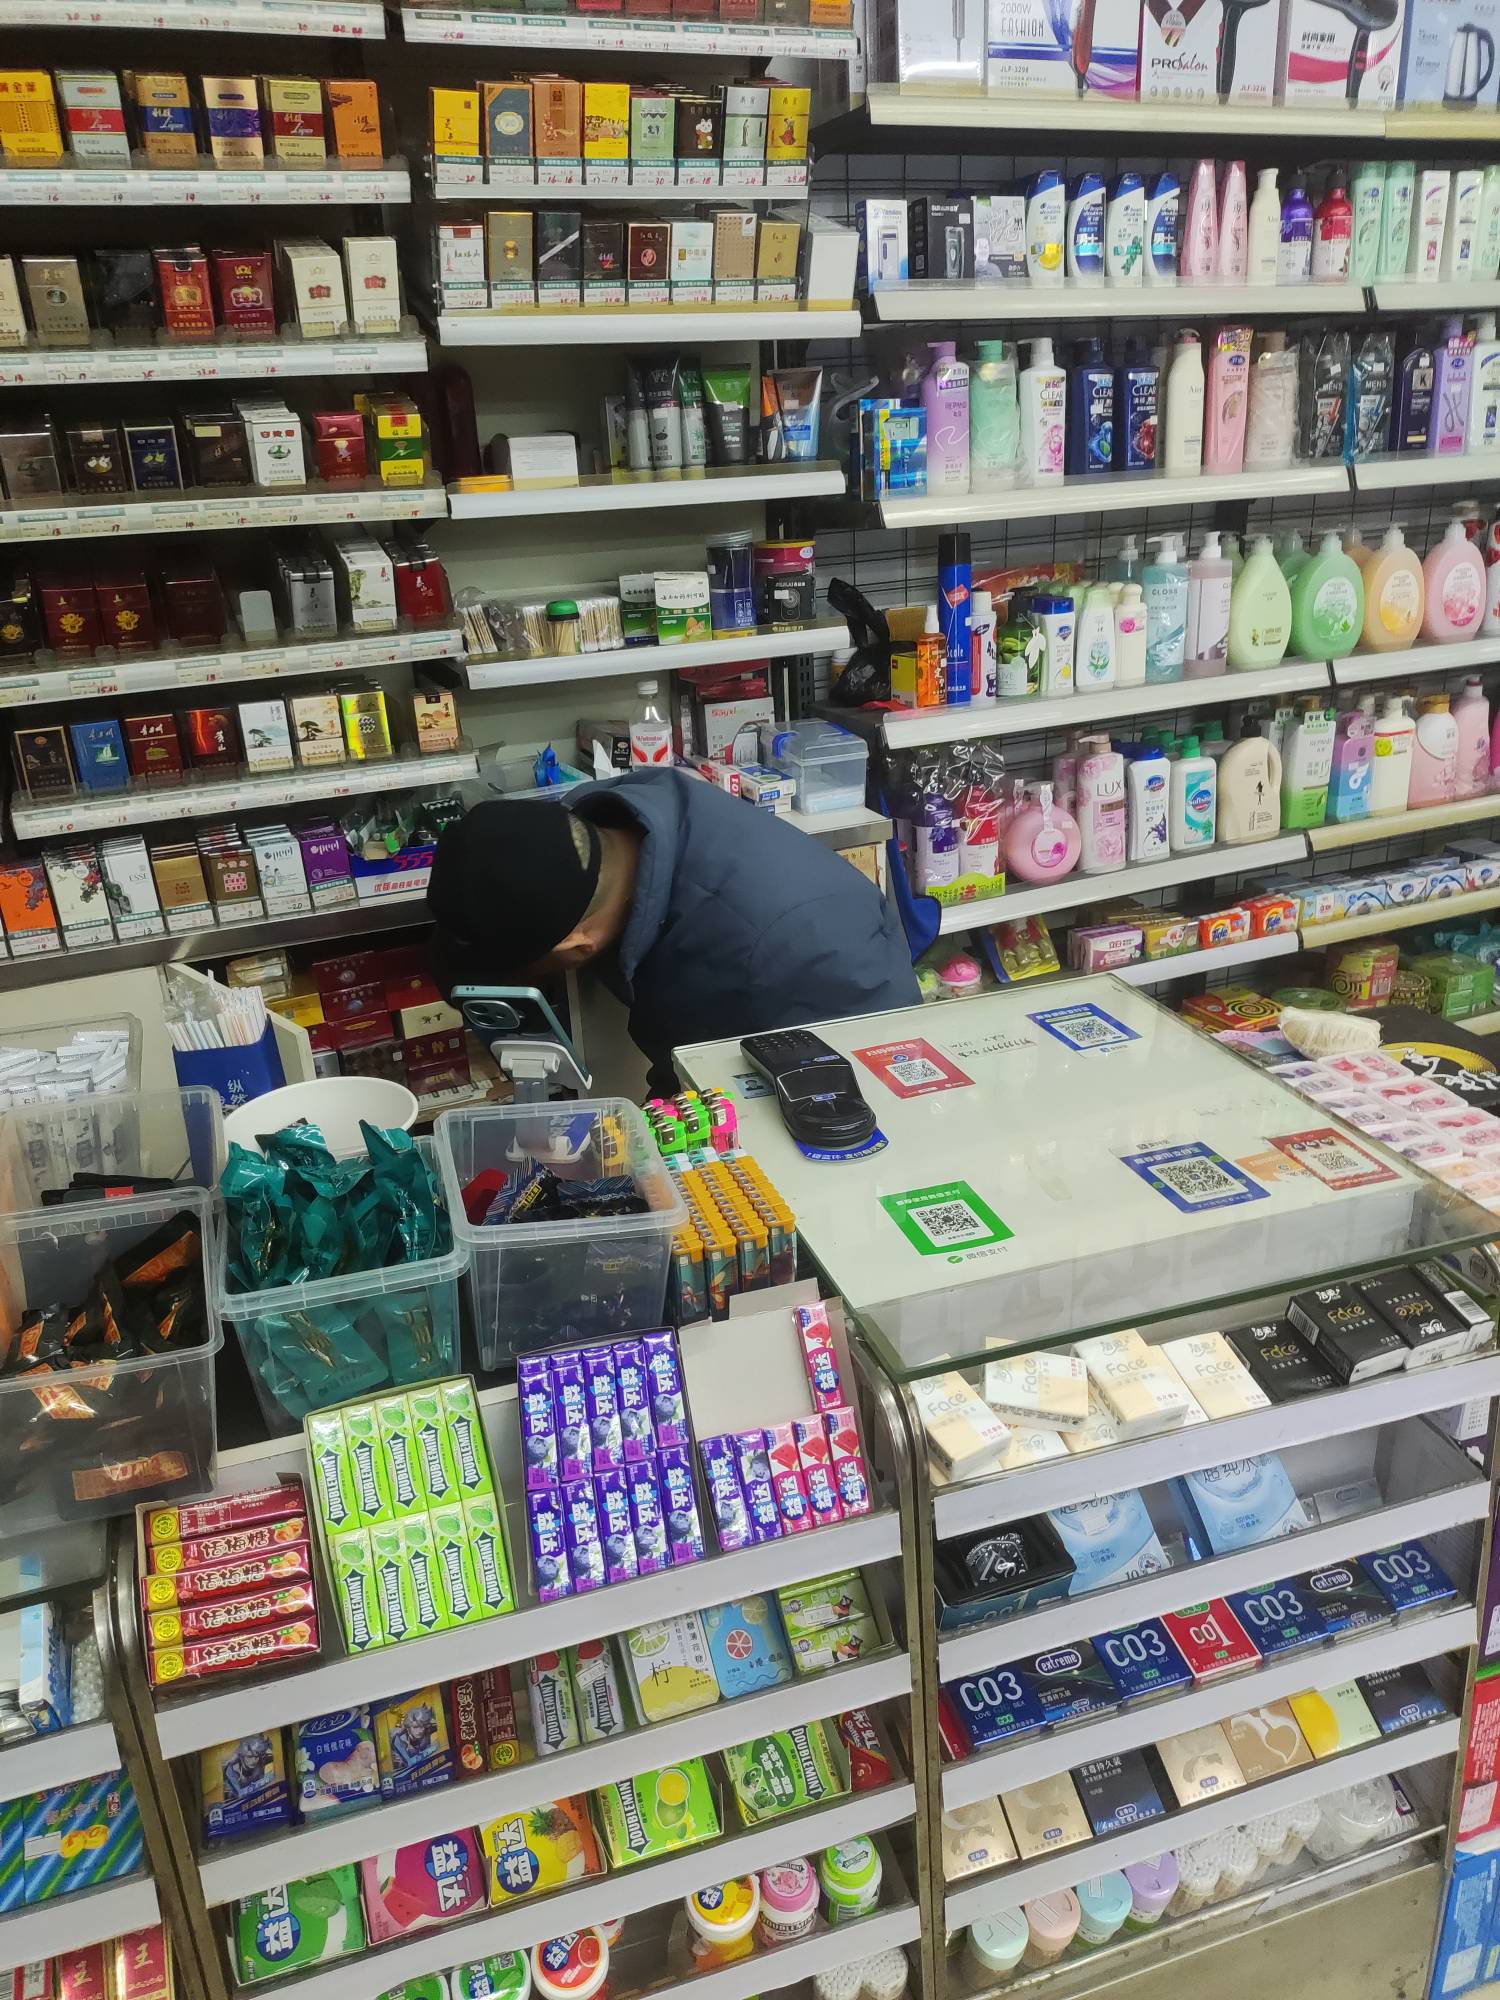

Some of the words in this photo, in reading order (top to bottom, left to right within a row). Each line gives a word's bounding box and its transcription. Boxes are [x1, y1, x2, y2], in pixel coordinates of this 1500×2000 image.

[1001, 19, 1044, 38] FASHION
[1301, 32, 1336, 42] 时尚家用
[1132, 385, 1157, 396] CLEAR
[1365, 380, 1387, 389] MENS
[1096, 779, 1123, 797] LUX
[1211, 926, 1229, 941] Tide
[1265, 916, 1282, 930] Tide
[966, 1246, 1008, 1260] 微信支付
[1327, 1304, 1366, 1323] Face
[651, 1352, 676, 1394] 益达
[1106, 1357, 1148, 1377] Face
[1260, 1344, 1300, 1362] Face
[562, 1384, 586, 1426] 益达
[593, 1374, 616, 1416] 益达
[620, 1366, 644, 1407] 益达
[523, 1392, 549, 1434] 益达
[387, 1438, 417, 1505] DOUBLEMINT
[422, 1431, 451, 1498] DOUBLEMINT
[454, 1422, 481, 1488] DOUBLEMINT
[325, 1453, 347, 1524] DOUBLEMINT
[354, 1446, 381, 1516] DOUBLEMINT
[665, 1466, 694, 1510] 益达
[570, 1500, 598, 1544] 益达
[604, 1491, 631, 1534] 益达
[634, 1482, 661, 1523] 益达
[534, 1511, 563, 1555] 益达
[411, 1555, 438, 1627] DOUBLEMINT
[443, 1546, 471, 1617] DOUBLEMINT
[476, 1535, 502, 1606] DOUBLEMINT
[1315, 1573, 1350, 1590] extreme
[344, 1575, 370, 1646] DOUBLEMINT
[379, 1565, 405, 1638] DOUBLEMINT
[649, 1660, 672, 1687] 柠
[1040, 1653, 1078, 1671] extreme
[542, 1681, 565, 1742] DOUBLEMINT
[498, 1817, 530, 1889] 益达
[433, 1840, 469, 1912] 益达
